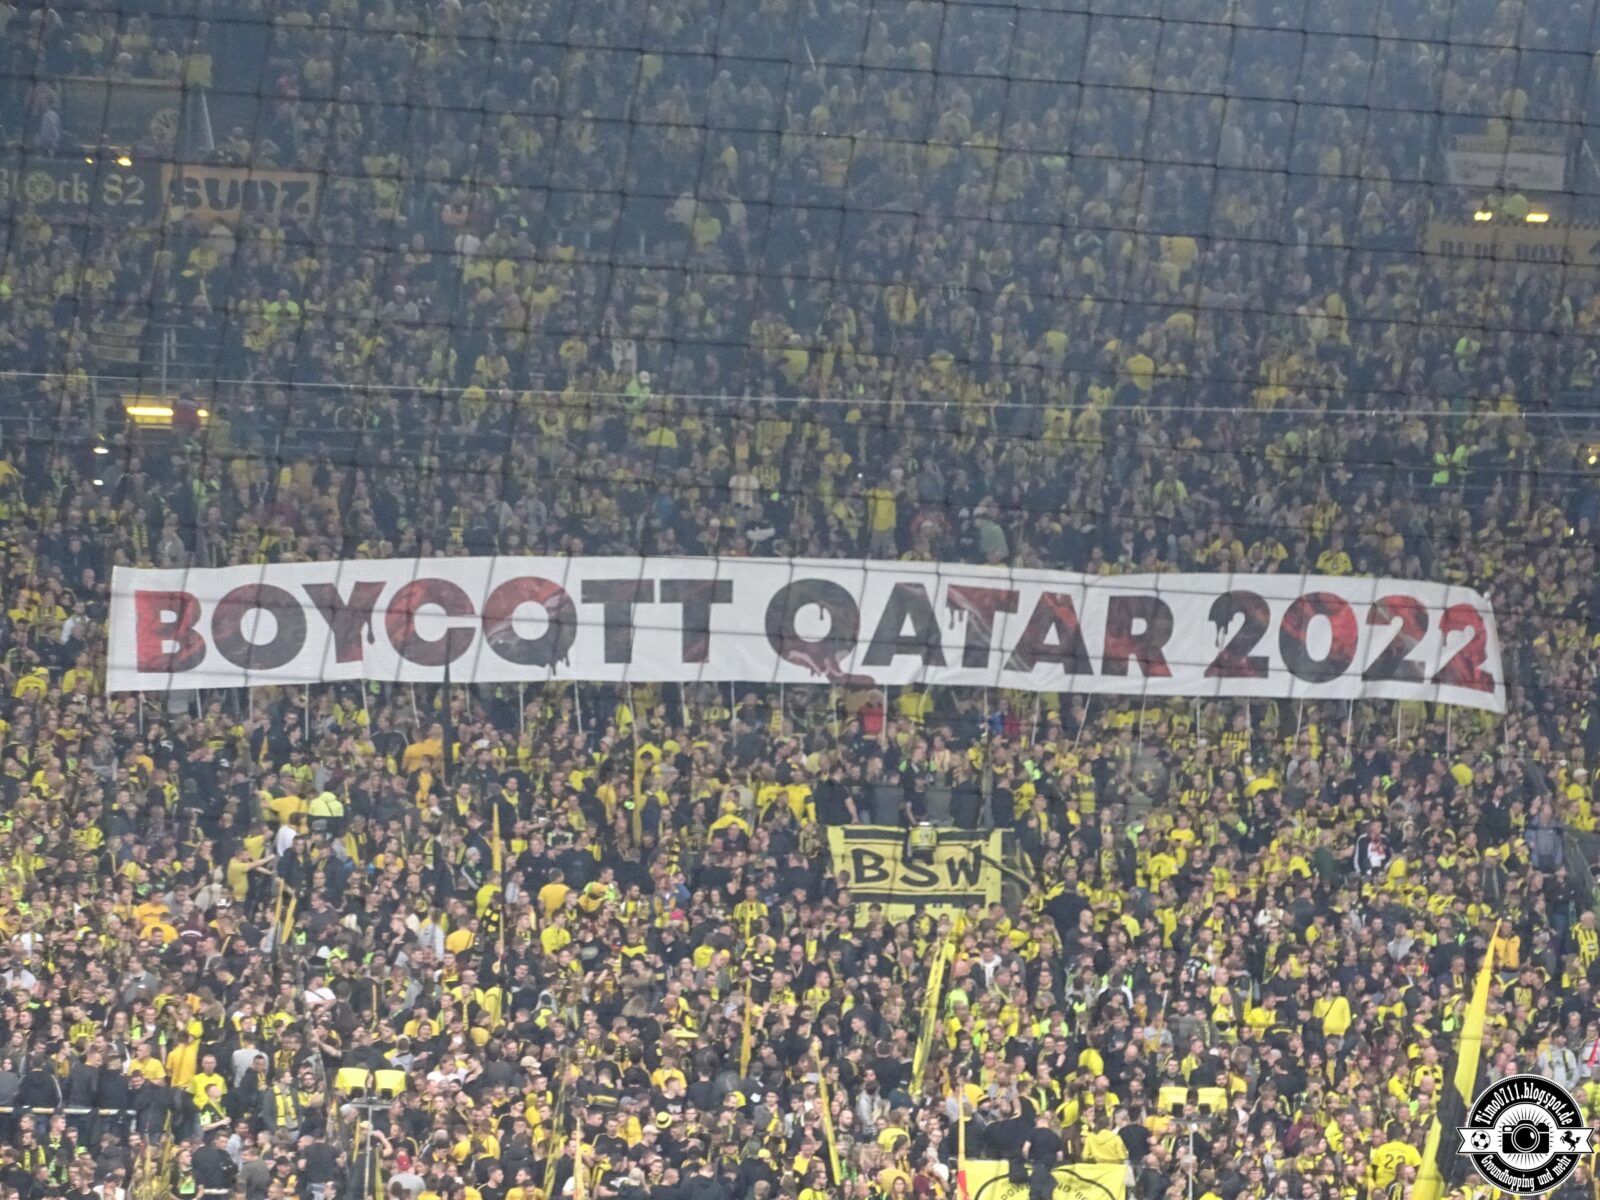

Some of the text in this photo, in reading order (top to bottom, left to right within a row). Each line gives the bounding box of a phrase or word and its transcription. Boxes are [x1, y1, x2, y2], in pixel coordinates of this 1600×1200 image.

[103, 173, 145, 206] 82
[135, 576, 1495, 693] BOYCOTT QATAR 2022
[851, 845, 983, 888] BSW
